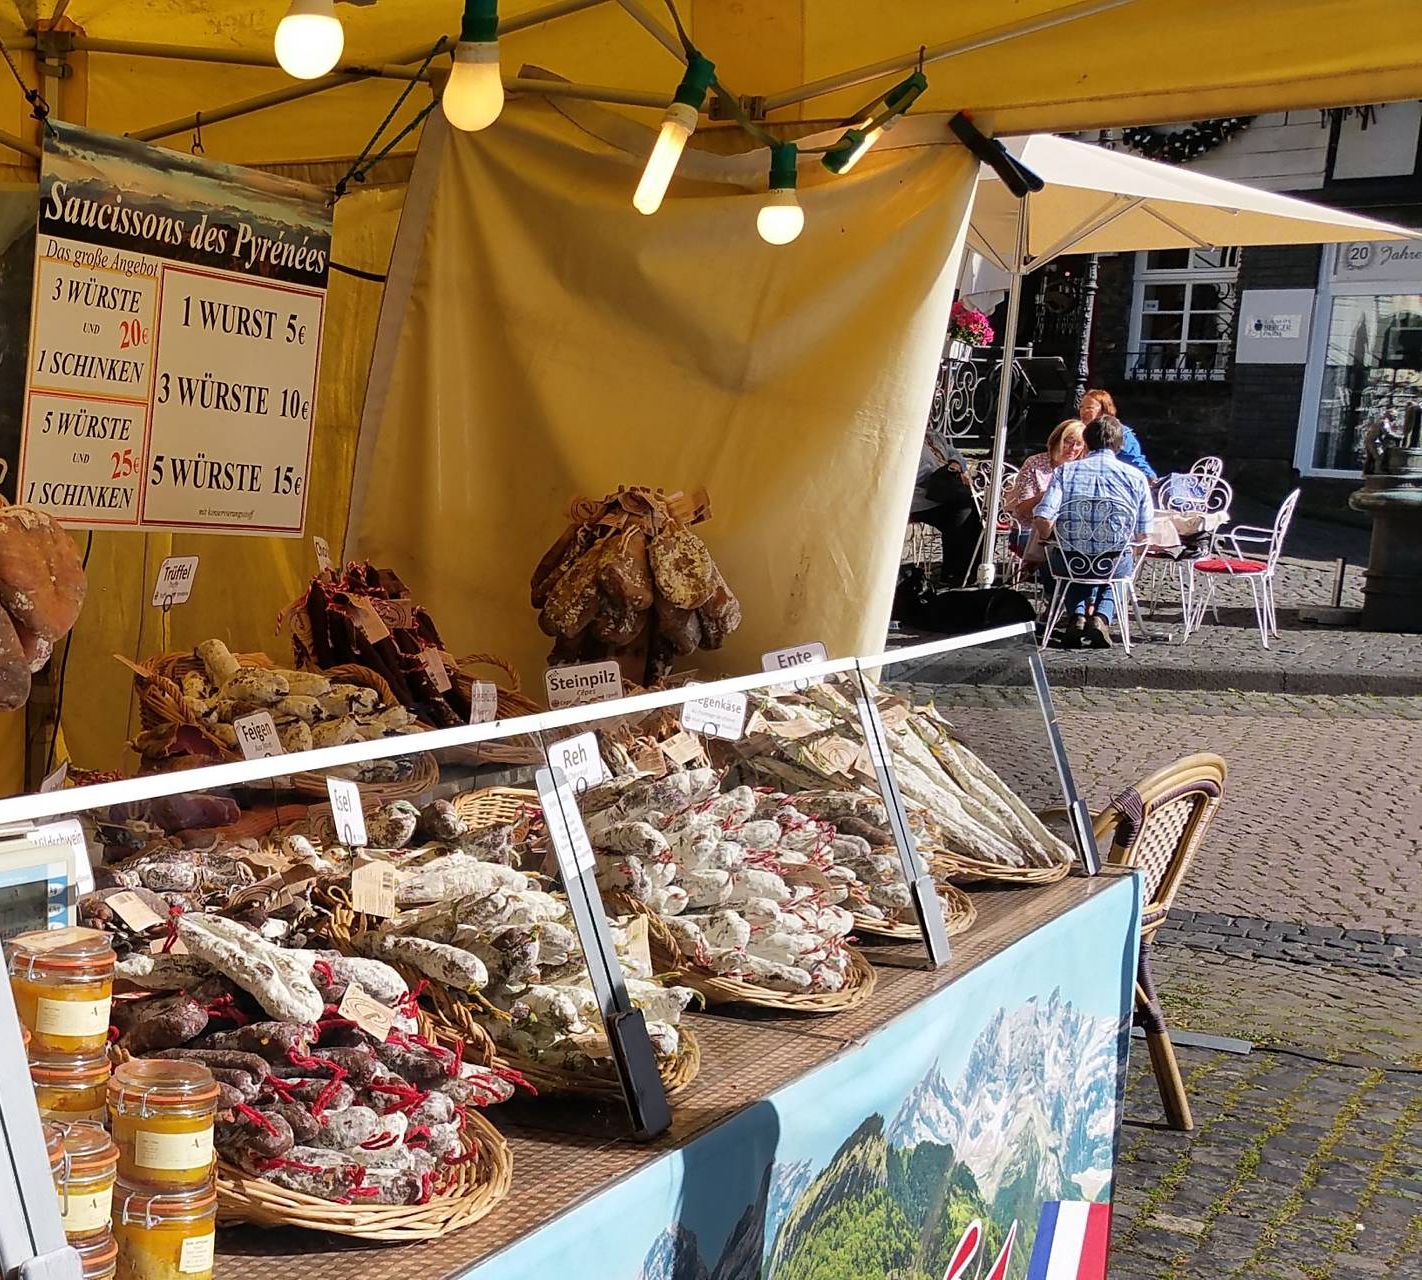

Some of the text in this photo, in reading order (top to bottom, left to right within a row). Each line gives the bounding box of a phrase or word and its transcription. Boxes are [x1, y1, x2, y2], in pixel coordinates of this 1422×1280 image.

[45, 181, 326, 273] Saucissons des Pyrénées
[46, 239, 158, 277] Das große Angebot
[1351, 245, 1422, 265] 20 Jahre
[52, 277, 142, 313] 3 WÜRSTE
[83, 319, 149, 348] UND 20€
[182, 296, 306, 344] 1 WURST 5€
[38, 350, 144, 384] 1 SCHINKEN
[158, 373, 309, 420] 3 WÜRSTE 10€
[42, 409, 132, 440] 5 WÜRSTE
[73, 449, 140, 479] UND 25€
[151, 453, 302, 495] 5 WÜRSTE 15€
[26, 482, 134, 508] 1 SCHINKEN
[164, 564, 192, 581] Trüffel
[777, 651, 812, 669] Ente
[550, 670, 616, 691] Steinpilz
[242, 722, 272, 742] Feigen
[563, 743, 587, 769] Reh
